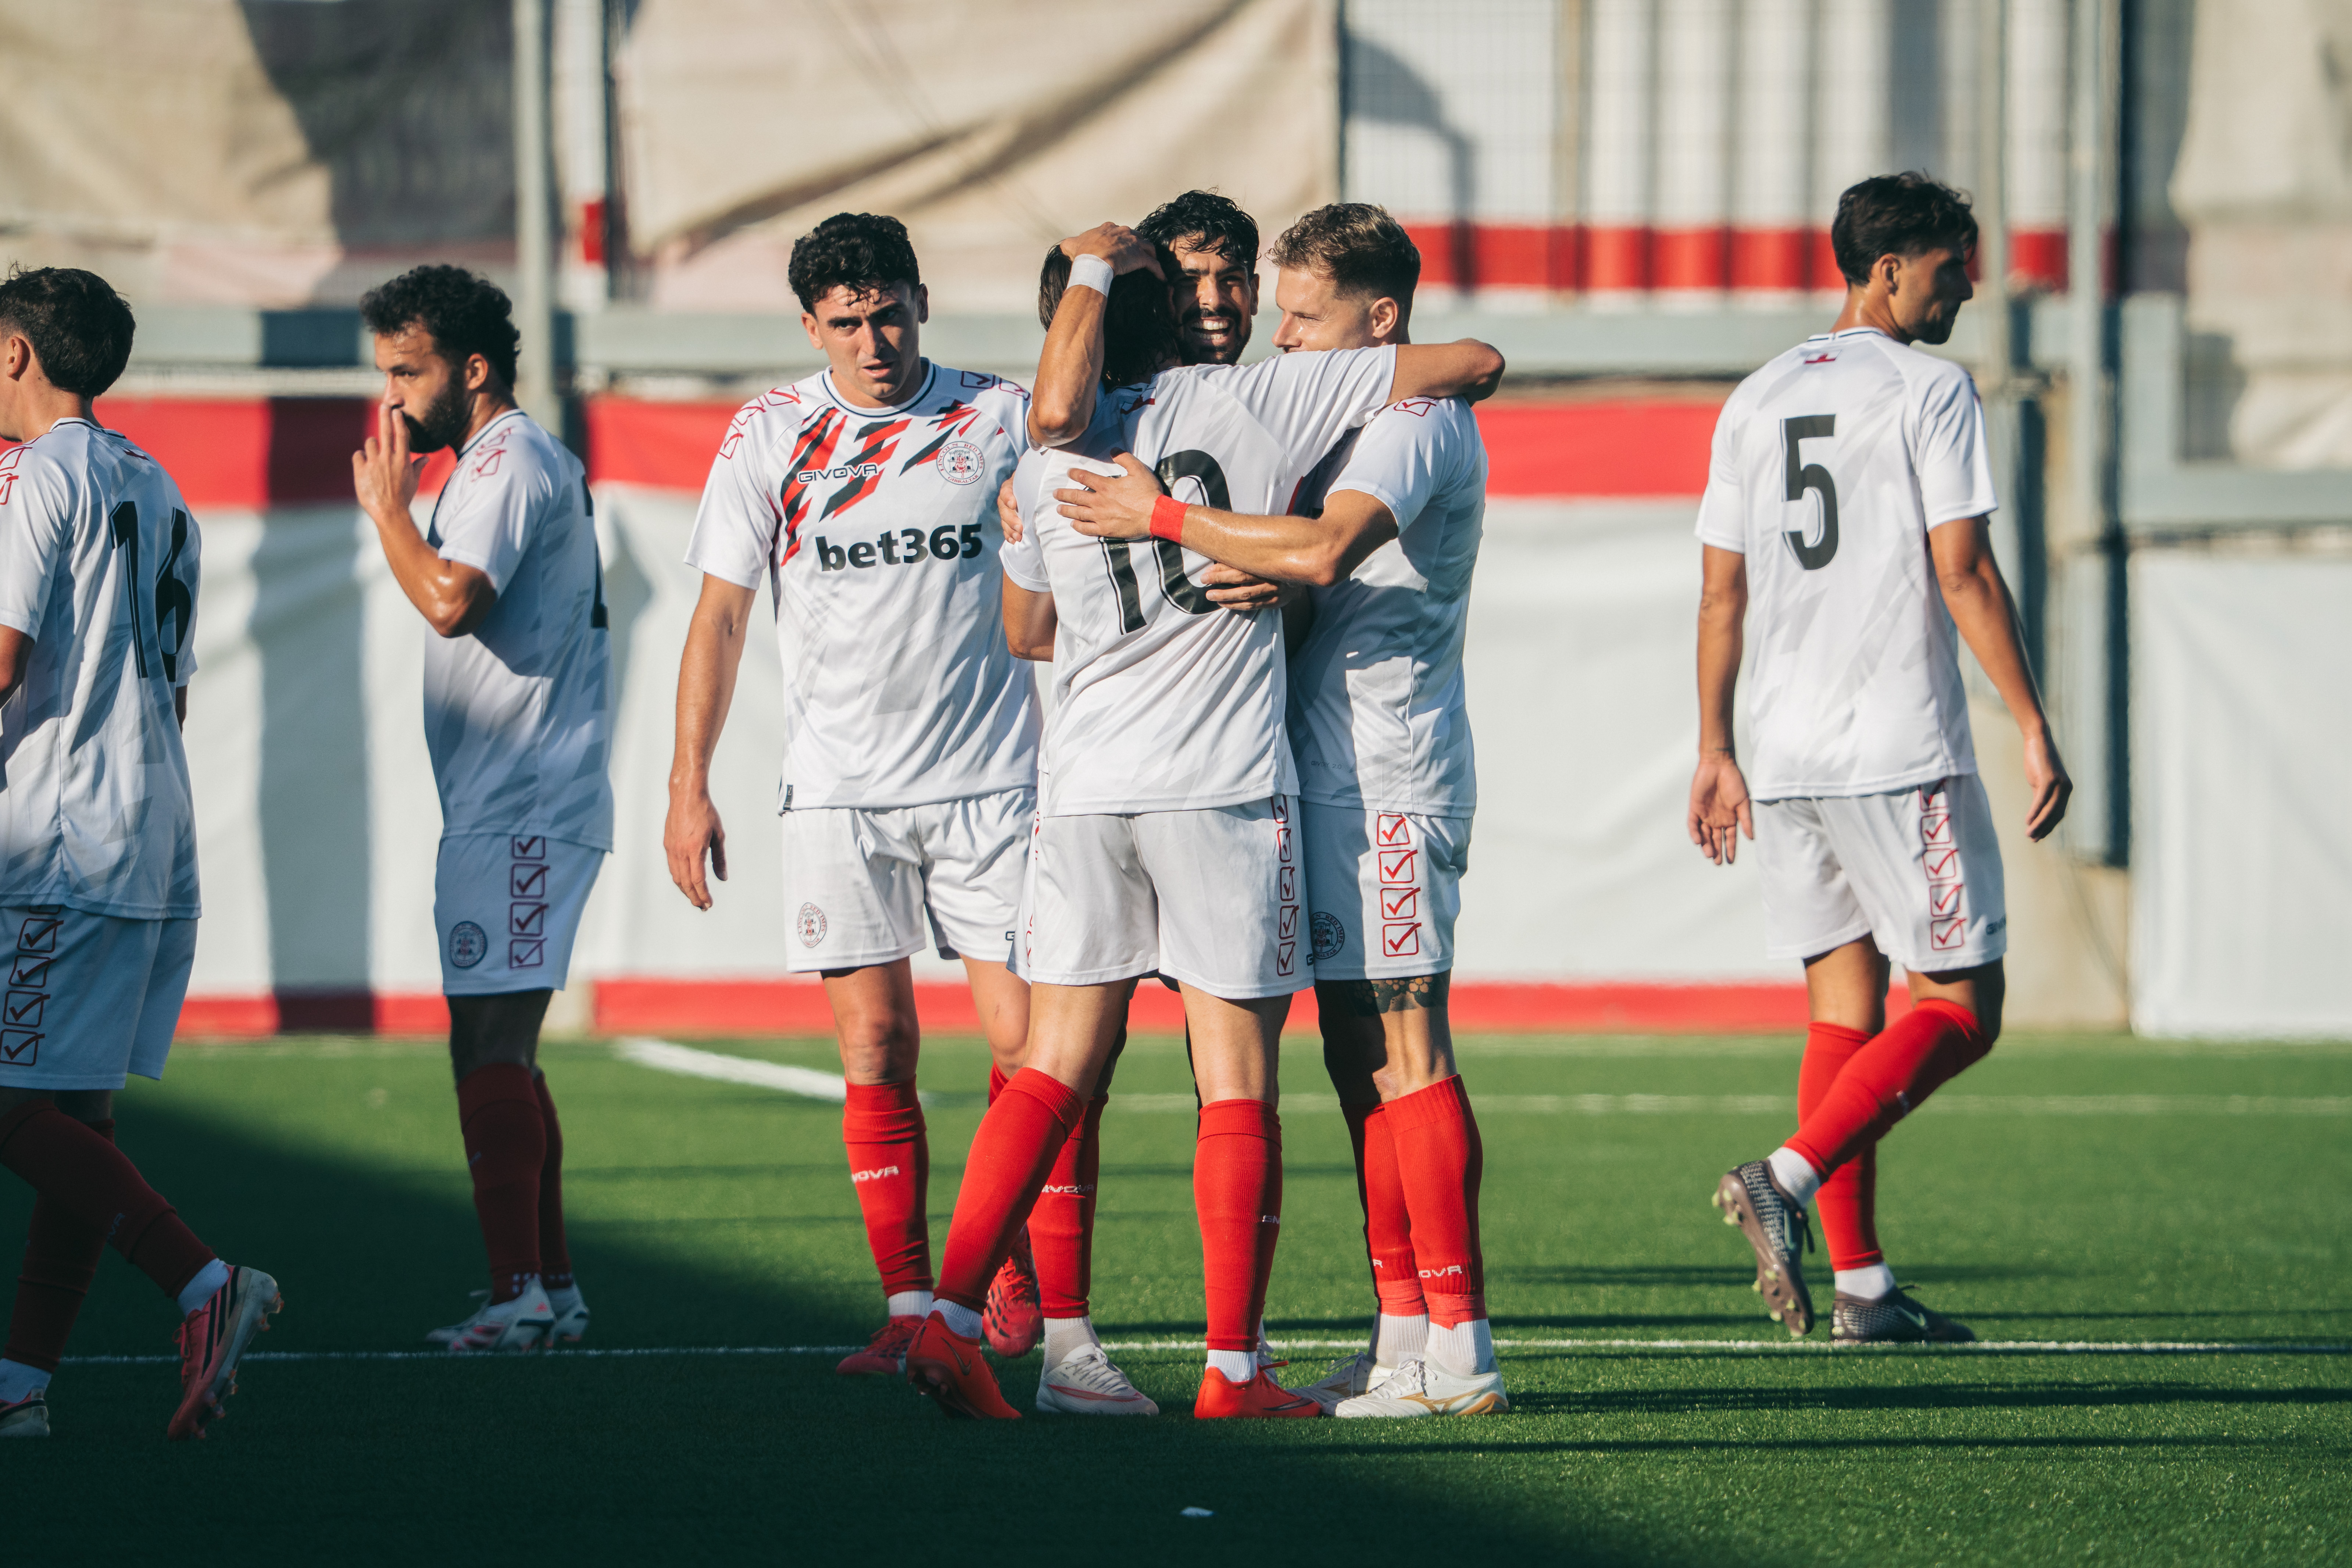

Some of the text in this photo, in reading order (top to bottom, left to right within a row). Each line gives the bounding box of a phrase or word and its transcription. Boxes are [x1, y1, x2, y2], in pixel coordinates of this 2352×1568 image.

[938, 443, 958, 471] LINCOLN
[964, 443, 977, 452] RED
[798, 464, 878, 482] GIVOVA
[948, 475, 979, 483] GIBRALTAR
[1780, 414, 1839, 571] 5
[815, 523, 983, 572] bet365
[109, 501, 192, 682] 16
[1325, 914, 1338, 925] RED
